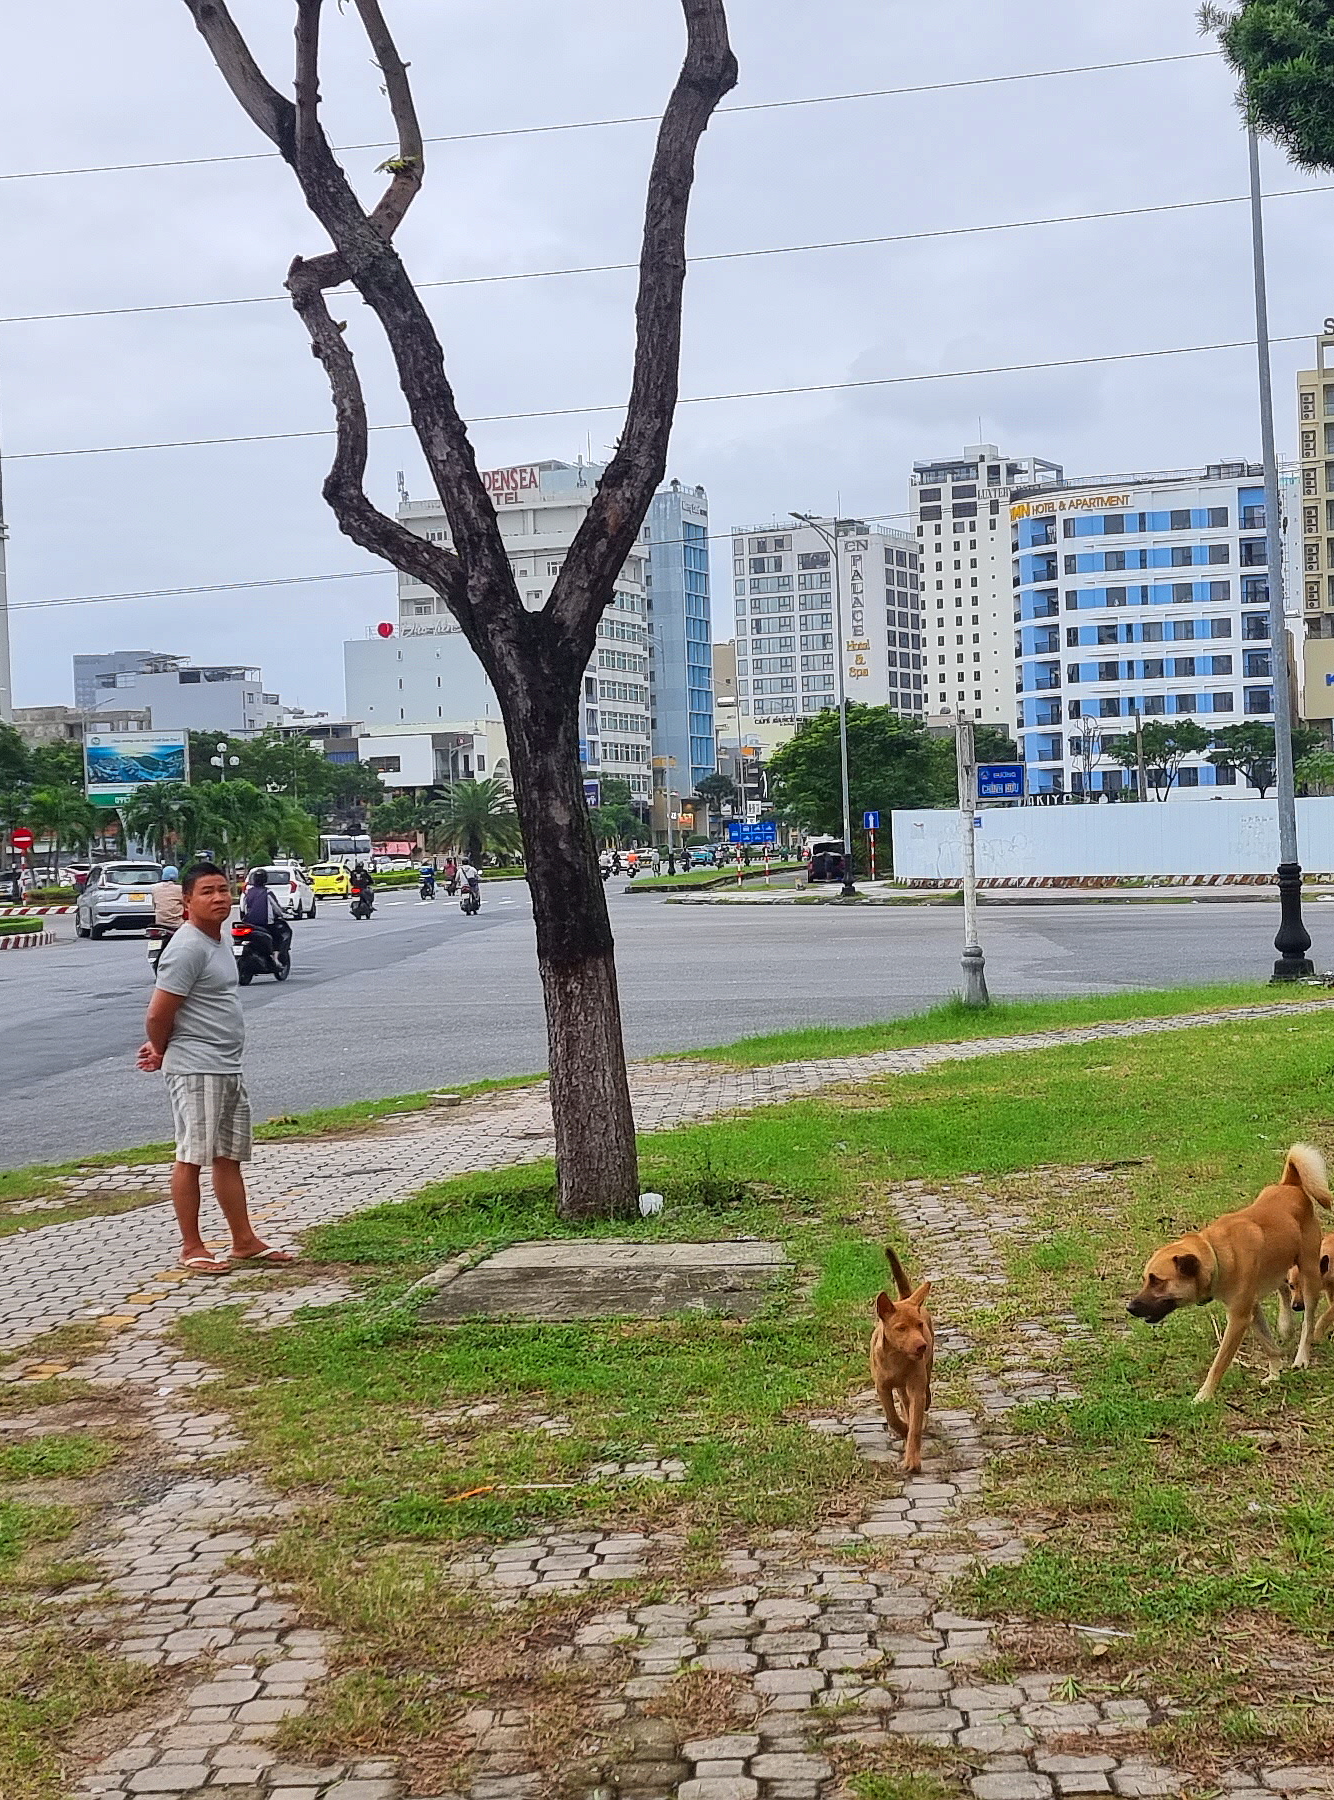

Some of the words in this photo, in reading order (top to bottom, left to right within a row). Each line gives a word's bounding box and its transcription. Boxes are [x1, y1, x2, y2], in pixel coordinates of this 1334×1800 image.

[481, 468, 538, 491] DENSEA
[493, 492, 524, 505] TEL
[1032, 502, 1057, 515] HOTEL
[1059, 500, 1066, 512] &
[1068, 495, 1130, 511] APARTMENT
[851, 554, 864, 636] PALACE
